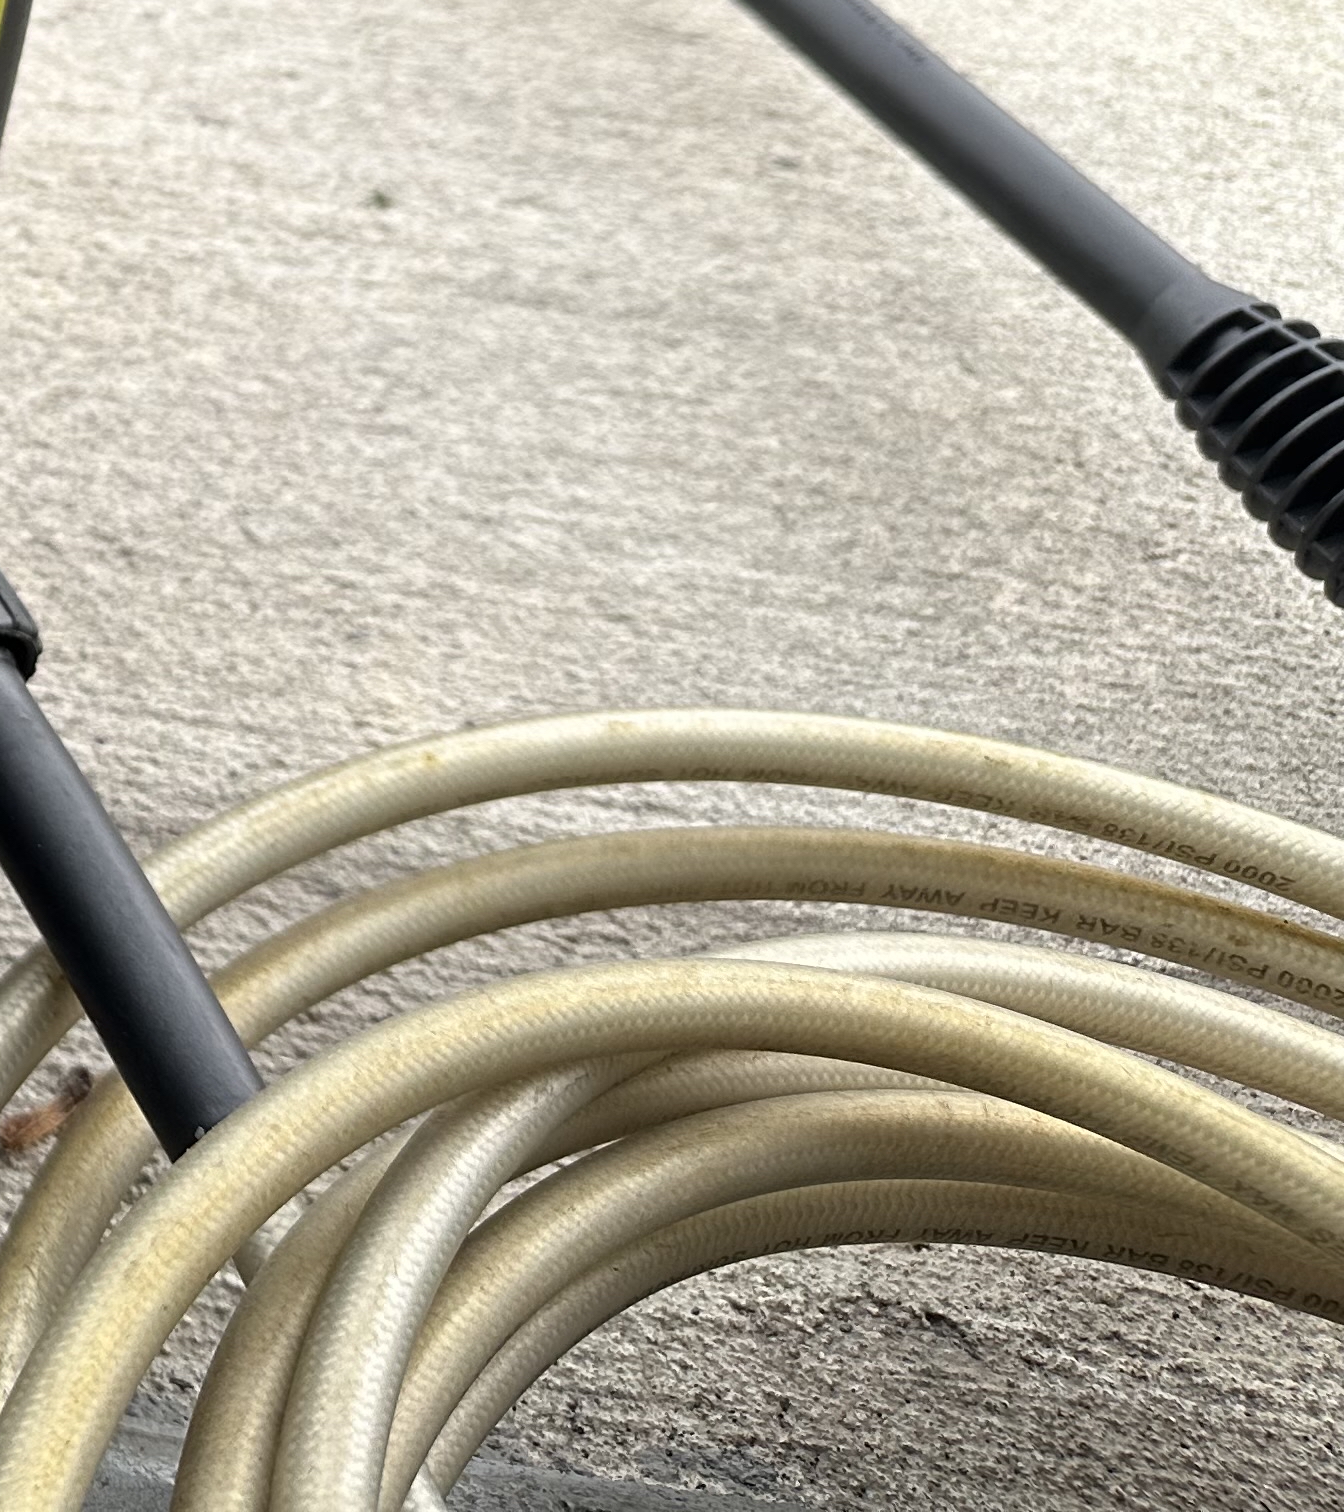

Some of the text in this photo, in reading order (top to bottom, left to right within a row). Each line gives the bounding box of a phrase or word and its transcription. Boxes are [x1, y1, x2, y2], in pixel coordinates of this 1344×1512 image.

[934, 787, 1015, 813] KEEP
[1100, 820, 1217, 867] PSI/138
[786, 879, 865, 896] FROM
[1223, 856, 1296, 894] 2000
[880, 883, 964, 907] AWAY
[979, 895, 1060, 925] KEEP
[1075, 913, 1142, 944] BAR
[1148, 930, 1269, 980] PSI/138
[1275, 968, 1344, 1007] 2000
[1006, 1231, 1089, 1253] KEEP
[1101, 1243, 1169, 1269] BAR
